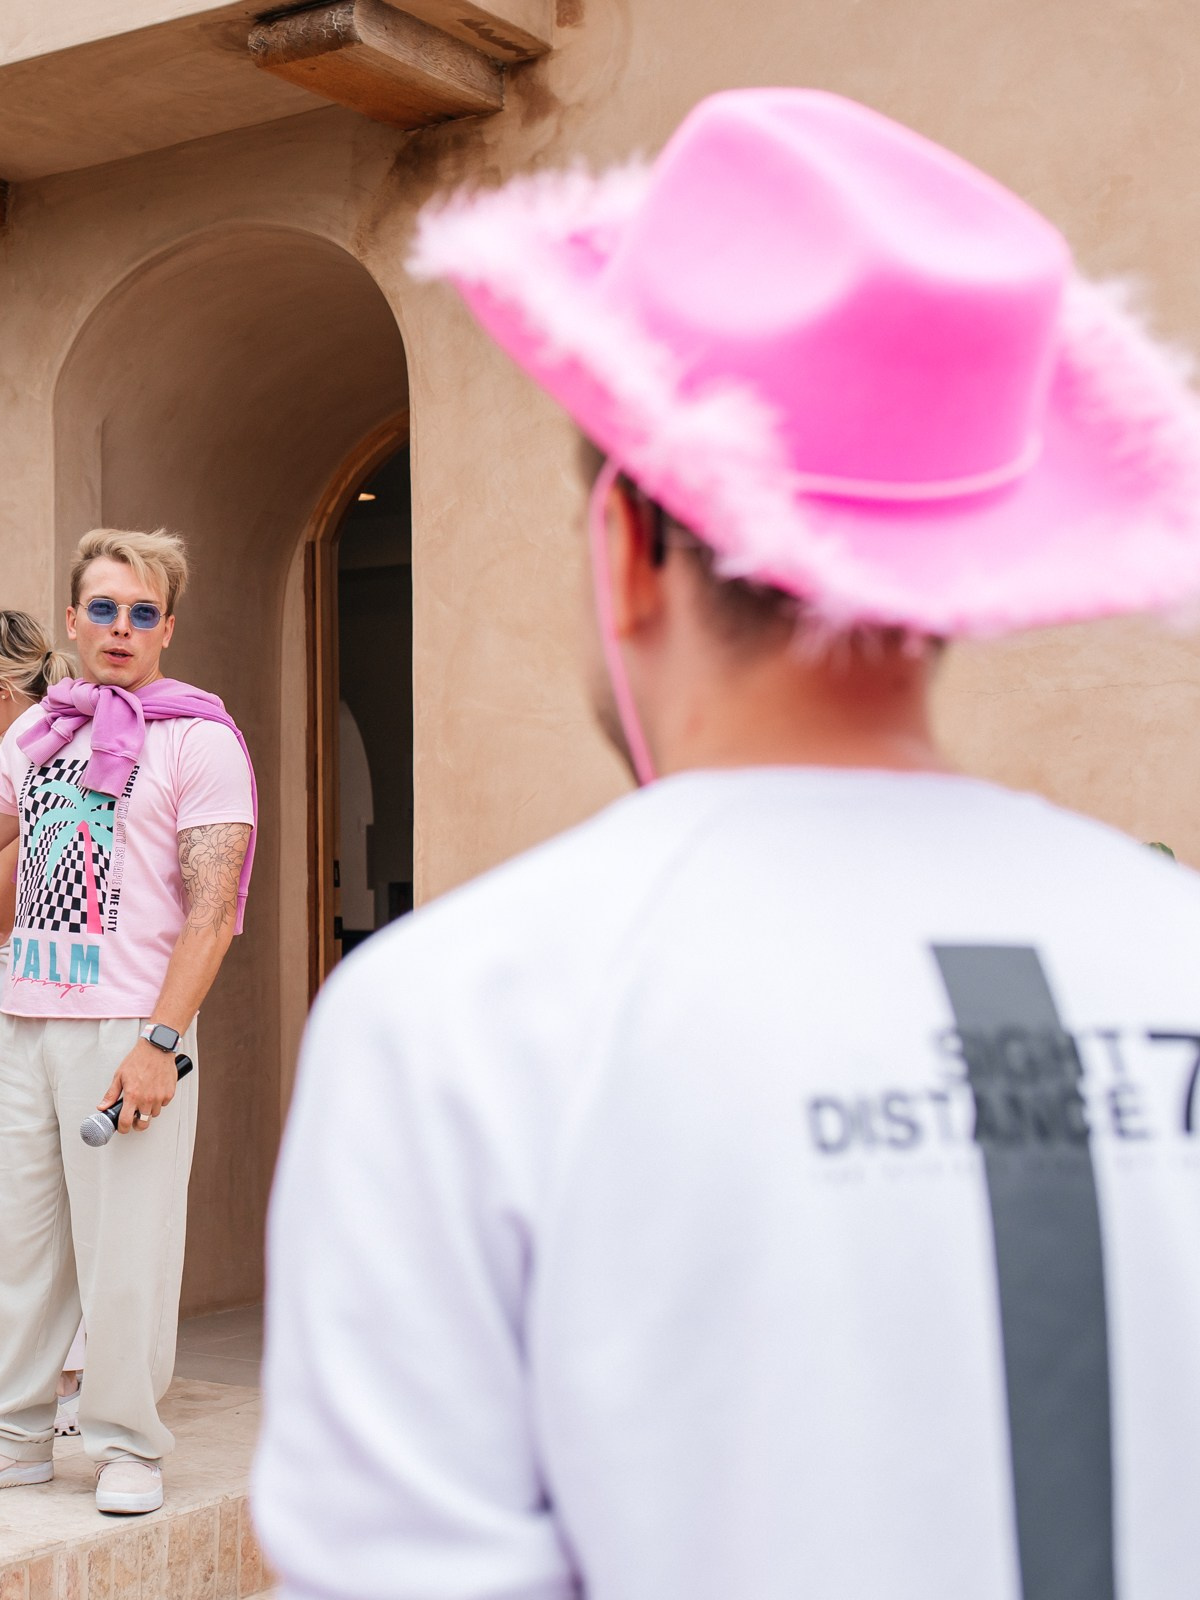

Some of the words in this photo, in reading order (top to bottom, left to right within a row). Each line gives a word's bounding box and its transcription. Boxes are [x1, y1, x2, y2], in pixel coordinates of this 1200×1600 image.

[109, 888, 121, 906] THE
[107, 909, 119, 932] CITY
[12, 937, 100, 985] PALM
[807, 1082, 1152, 1155] DISTANCE
